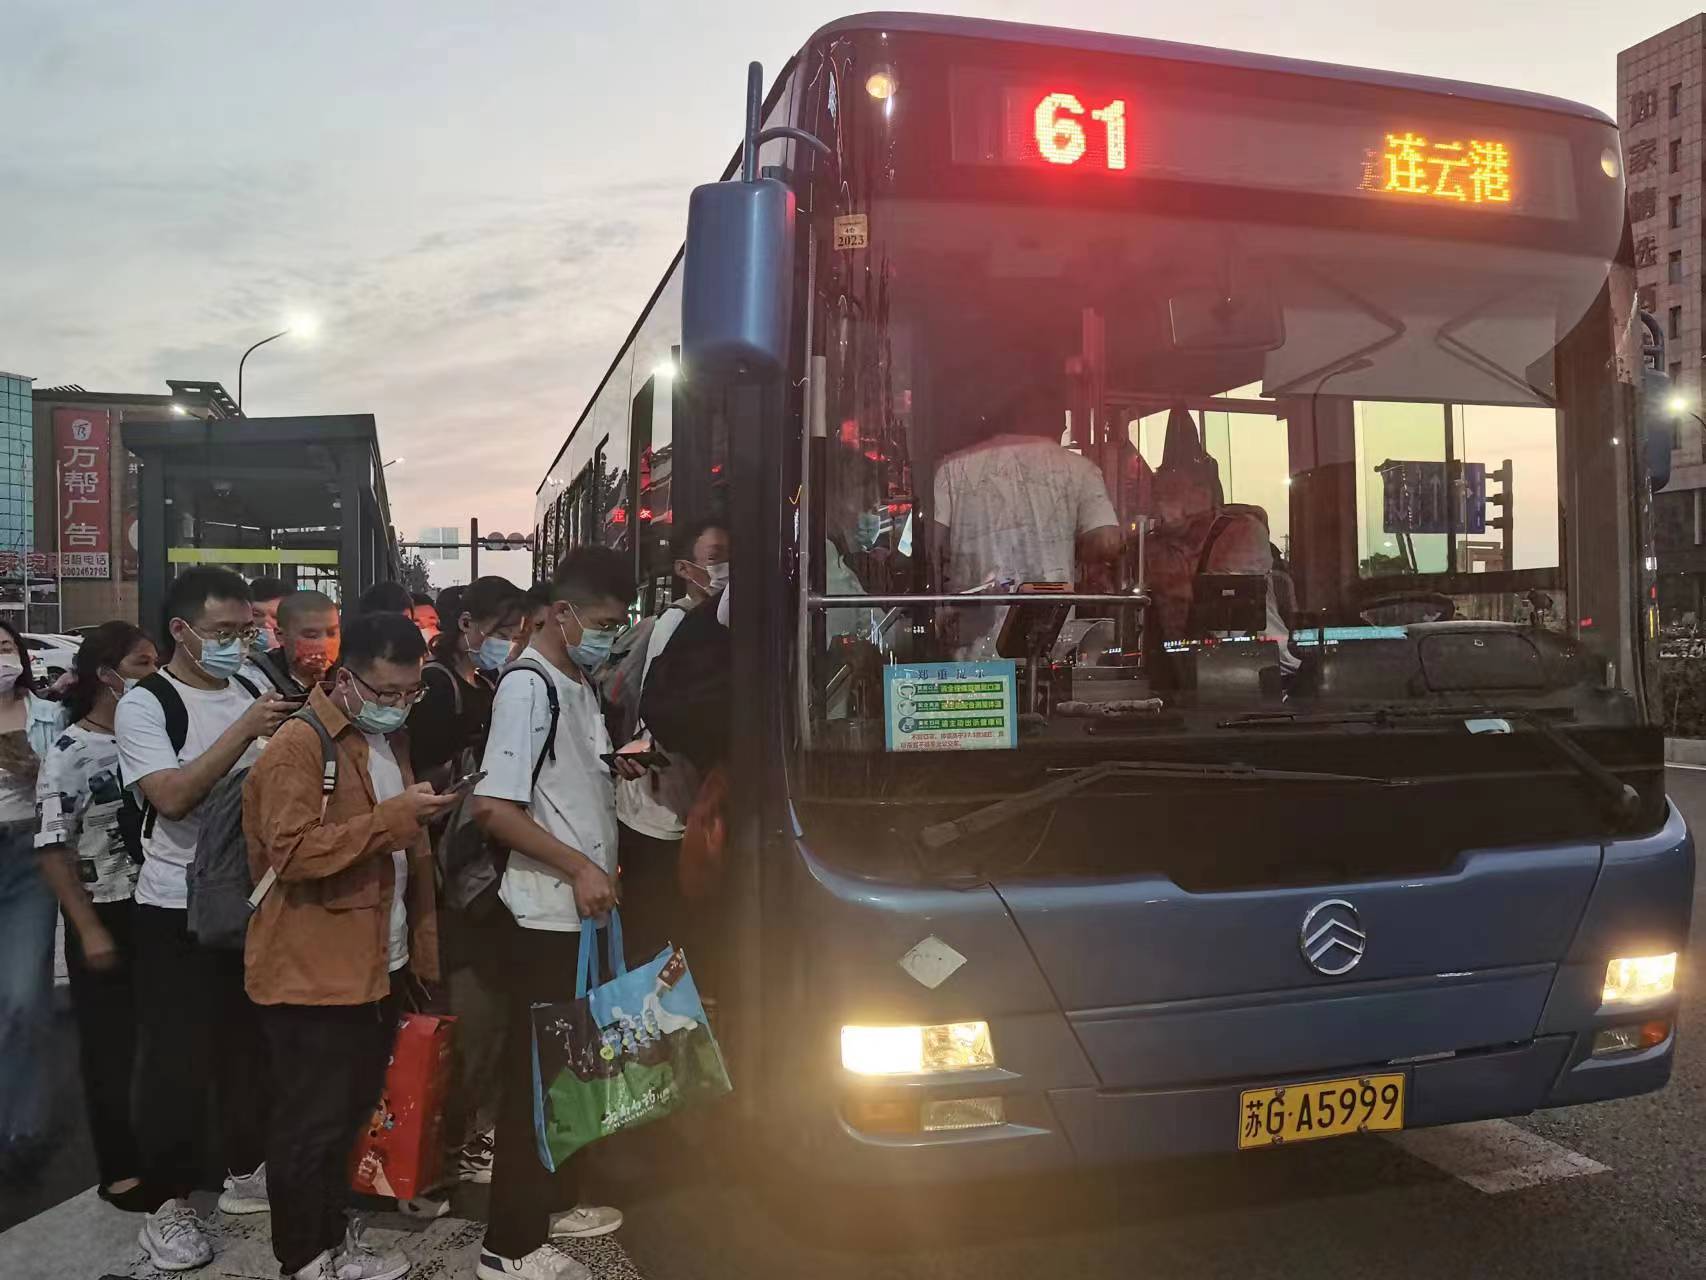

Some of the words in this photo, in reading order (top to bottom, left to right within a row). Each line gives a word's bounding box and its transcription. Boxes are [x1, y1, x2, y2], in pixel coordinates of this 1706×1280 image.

[1034, 92, 1127, 171] 61
[838, 235, 864, 246] 2023
[63, 445, 101, 547] 万帮广告
[918, 669, 984, 680] 郑重提示
[1245, 1083, 1400, 1138] 苏G·A5999
